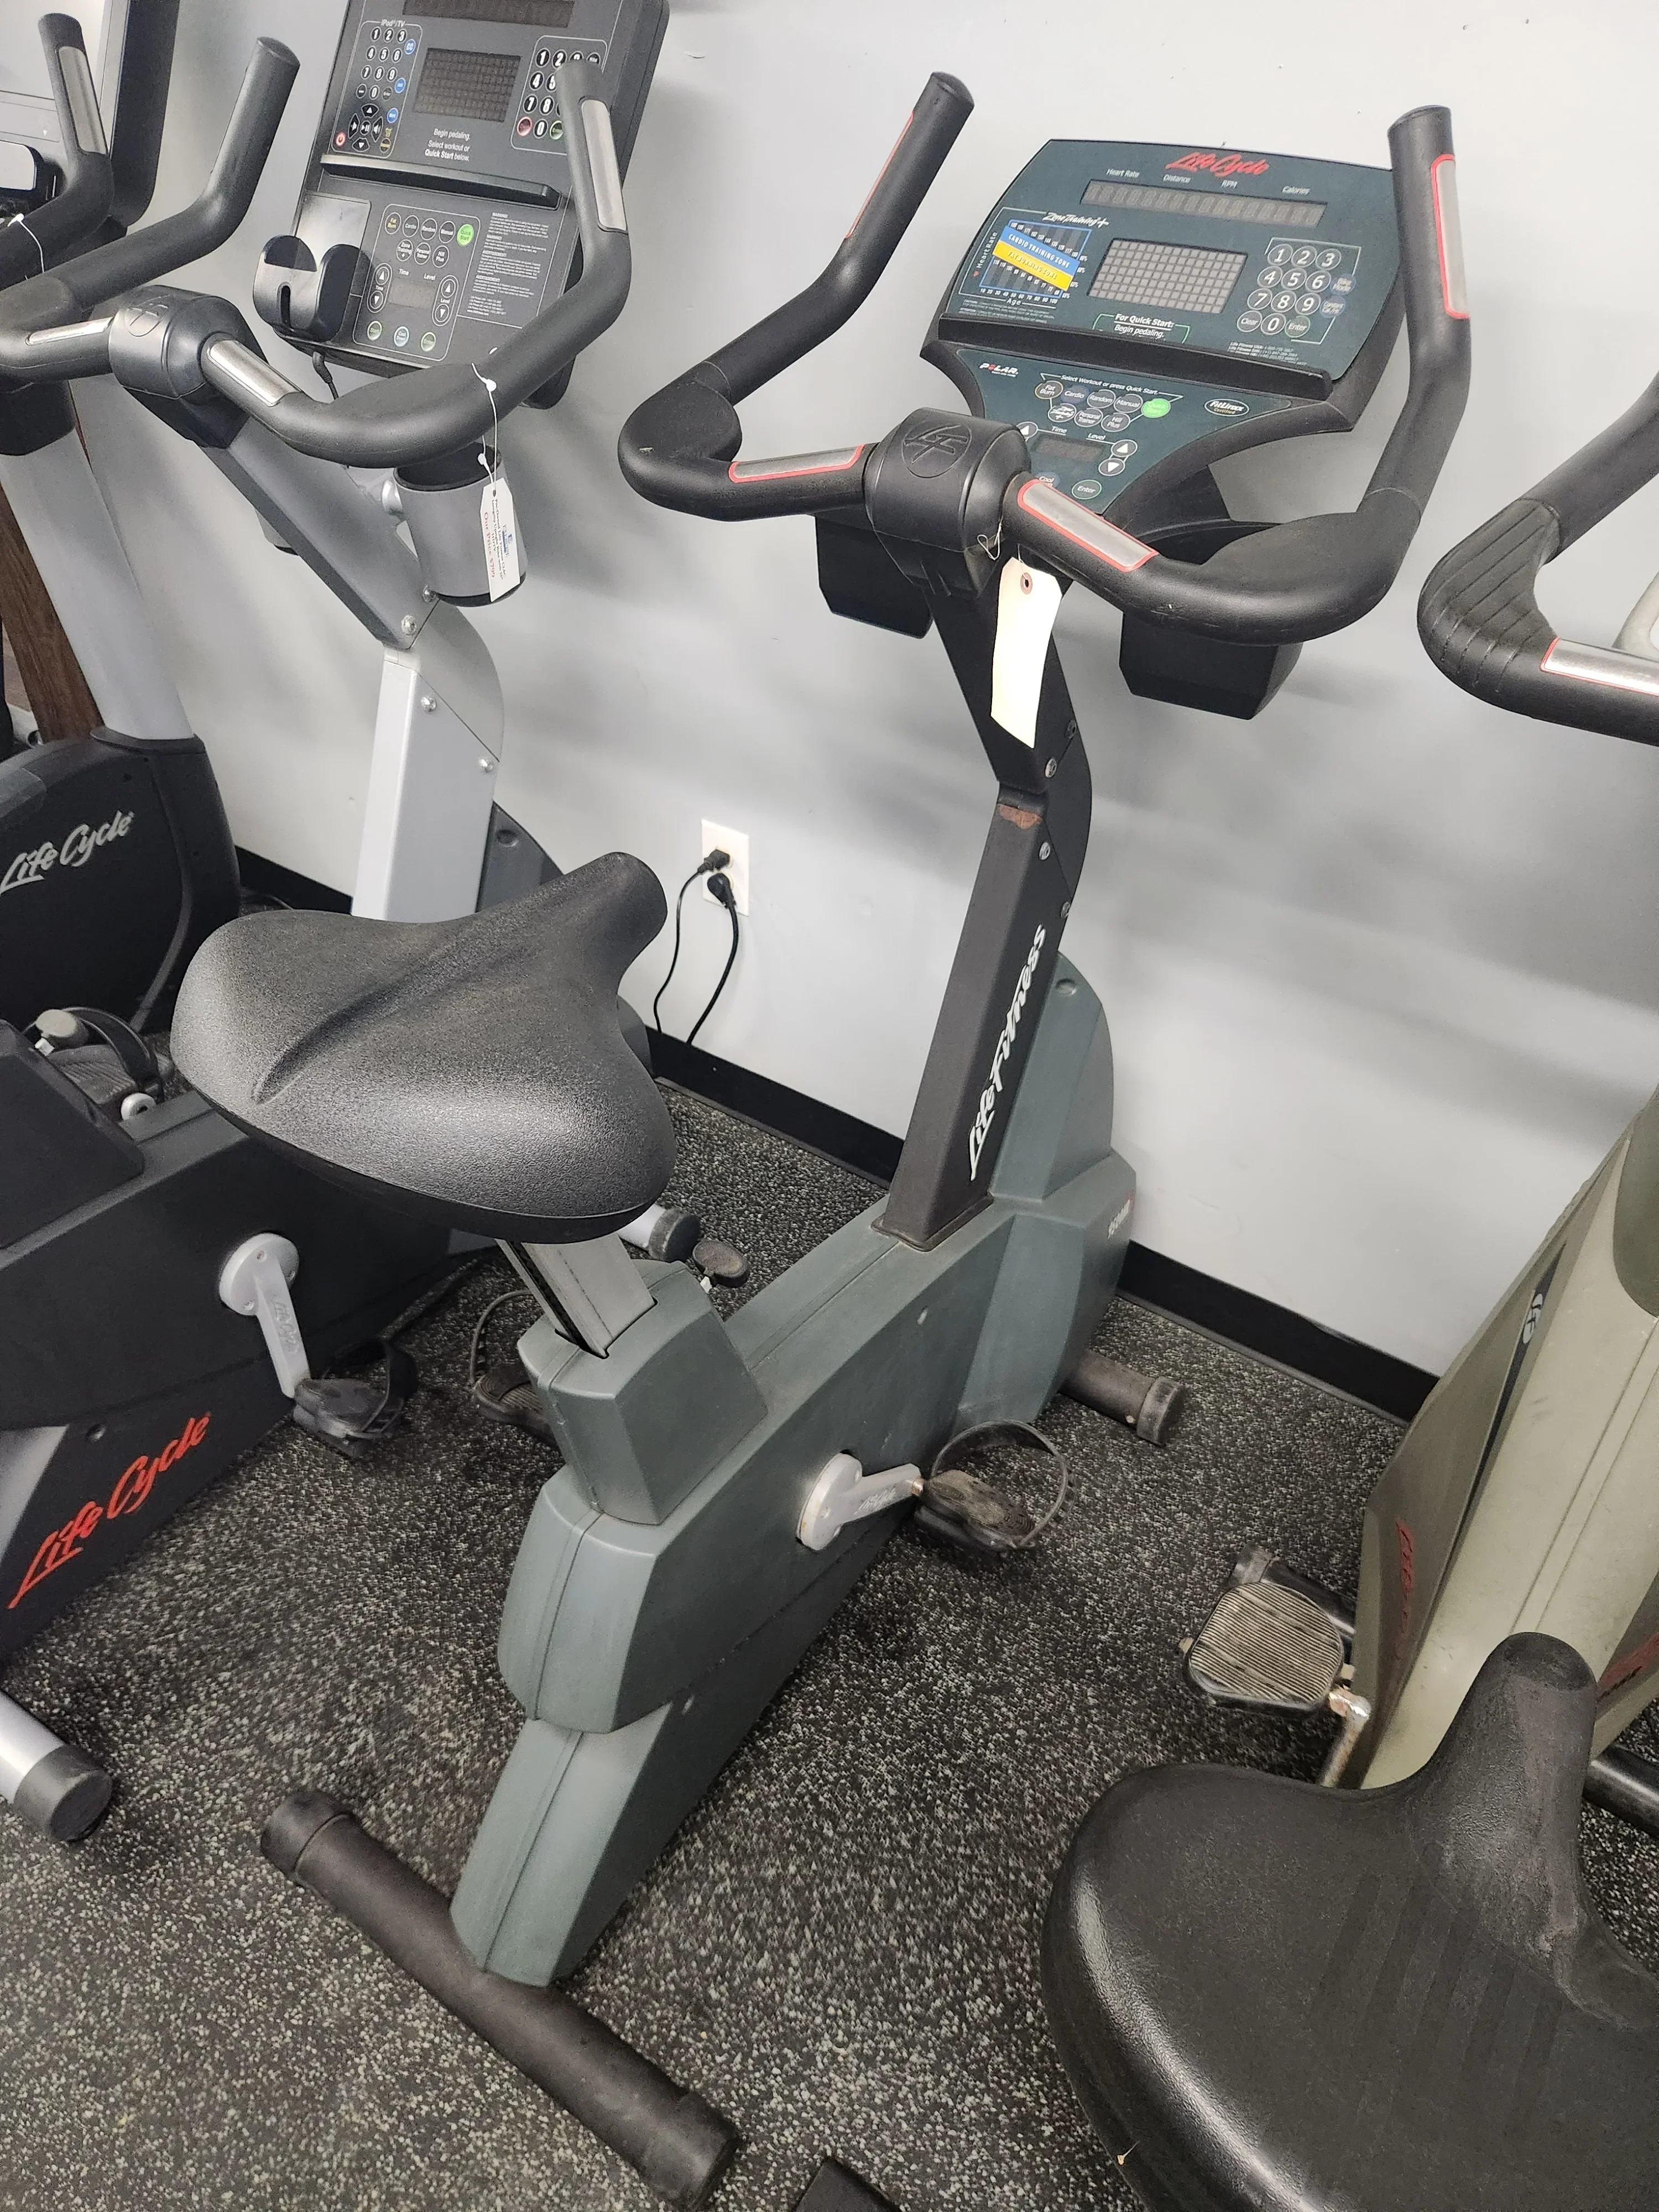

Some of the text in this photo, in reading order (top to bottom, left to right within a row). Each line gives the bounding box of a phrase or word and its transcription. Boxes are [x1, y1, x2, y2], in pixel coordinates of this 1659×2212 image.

[374, 29, 405, 41] 1 2 3
[368, 48, 399, 60] 4 5 6
[540, 51, 564, 66] 1 2
[364, 67, 395, 80] 7 8 9
[533, 74, 540, 88] 4
[372, 87, 377, 97] 0
[528, 97, 551, 112] 7 8
[434, 128, 470, 141] Begin pedaling.
[538, 122, 545, 135] 0
[428, 140, 444, 148] Select
[425, 149, 469, 161] Quick Start below.
[1107, 169, 1139, 179] Heart Rate
[1163, 174, 1191, 184] Distance
[1221, 180, 1238, 189] RPM
[1282, 186, 1311, 195] Calories
[976, 232, 998, 268] Heart Rate
[1009, 234, 1070, 268] CARDIO TRAINING ZONE
[1274, 249, 1335, 267] 1 2 3
[1008, 251, 1057, 280] FAT BURNING ZONE
[1264, 271, 1326, 289] 4 5 6
[1254, 293, 1268, 307] 7
[1277, 295, 1290, 309] 8
[1301, 297, 1314, 312] 9
[1129, 315, 1152, 325] Quick
[1151, 319, 1174, 328] Start:
[1241, 317, 1259, 326] Clear
[1267, 317, 1280, 331] 0
[1288, 322, 1307, 331] Enter
[1114, 324, 1133, 333] Begin
[1133, 327, 1165, 340] pedaling.
[1061, 374, 1078, 383] Select
[1079, 378, 1102, 386] Workout
[1090, 395, 1113, 403] Random
[1117, 399, 1140, 408] Manual
[0, 824, 132, 896] Life Cycle
[8, 1417, 210, 1609] Life Cycle
